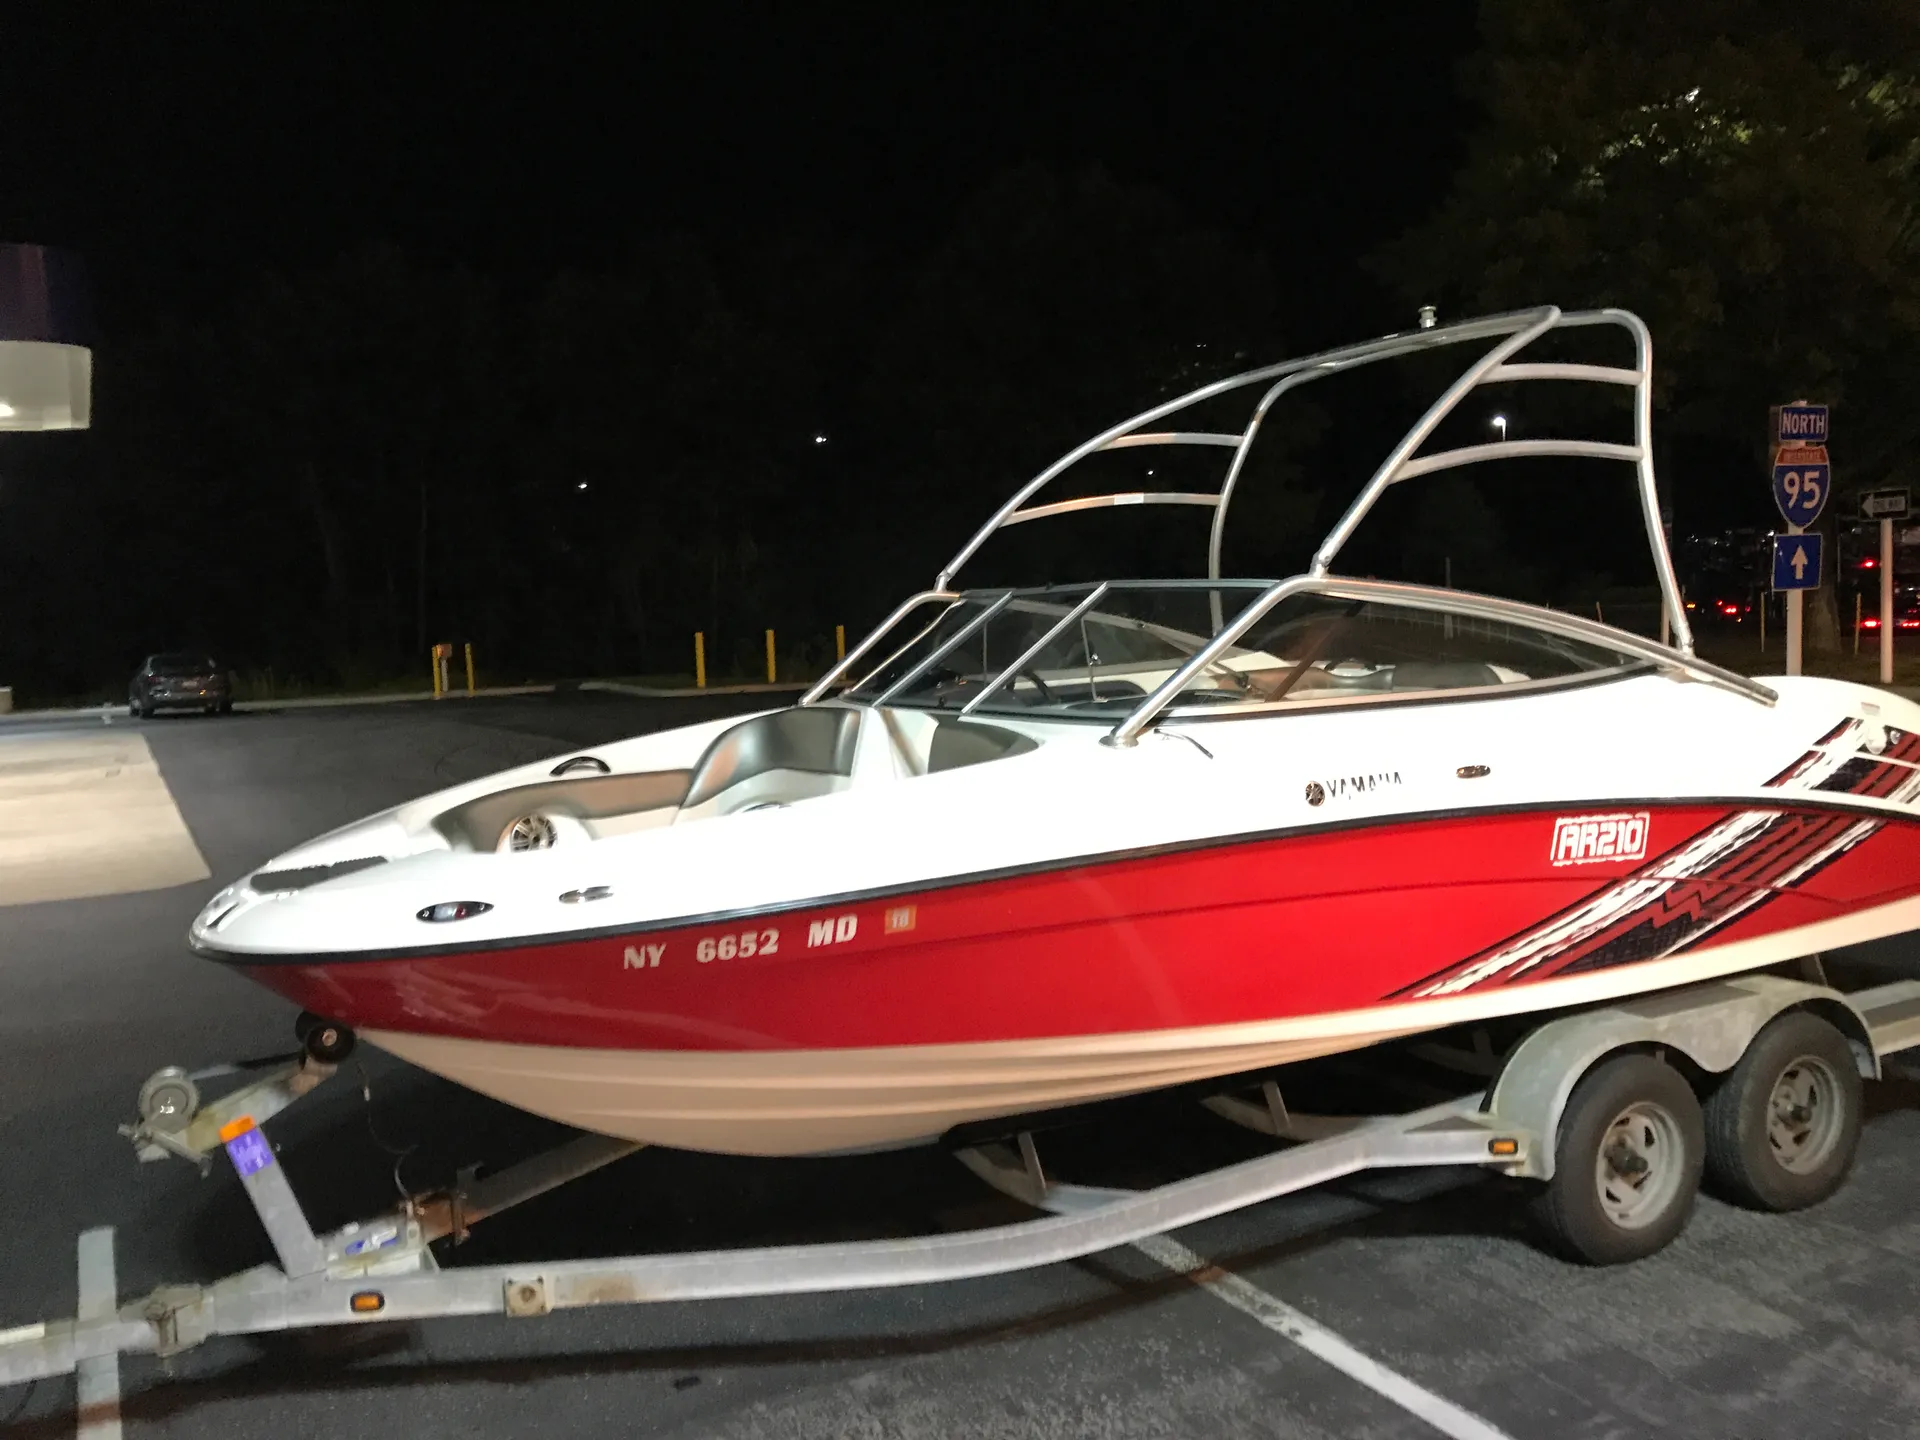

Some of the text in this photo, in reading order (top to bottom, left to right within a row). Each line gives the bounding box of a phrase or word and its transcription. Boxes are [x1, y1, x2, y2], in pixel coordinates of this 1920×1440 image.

[1782, 413, 1825, 434] NORTH
[1783, 471, 1821, 509] 95
[1557, 819, 1644, 860] AR210
[623, 914, 858, 970] NY 6652 MD
